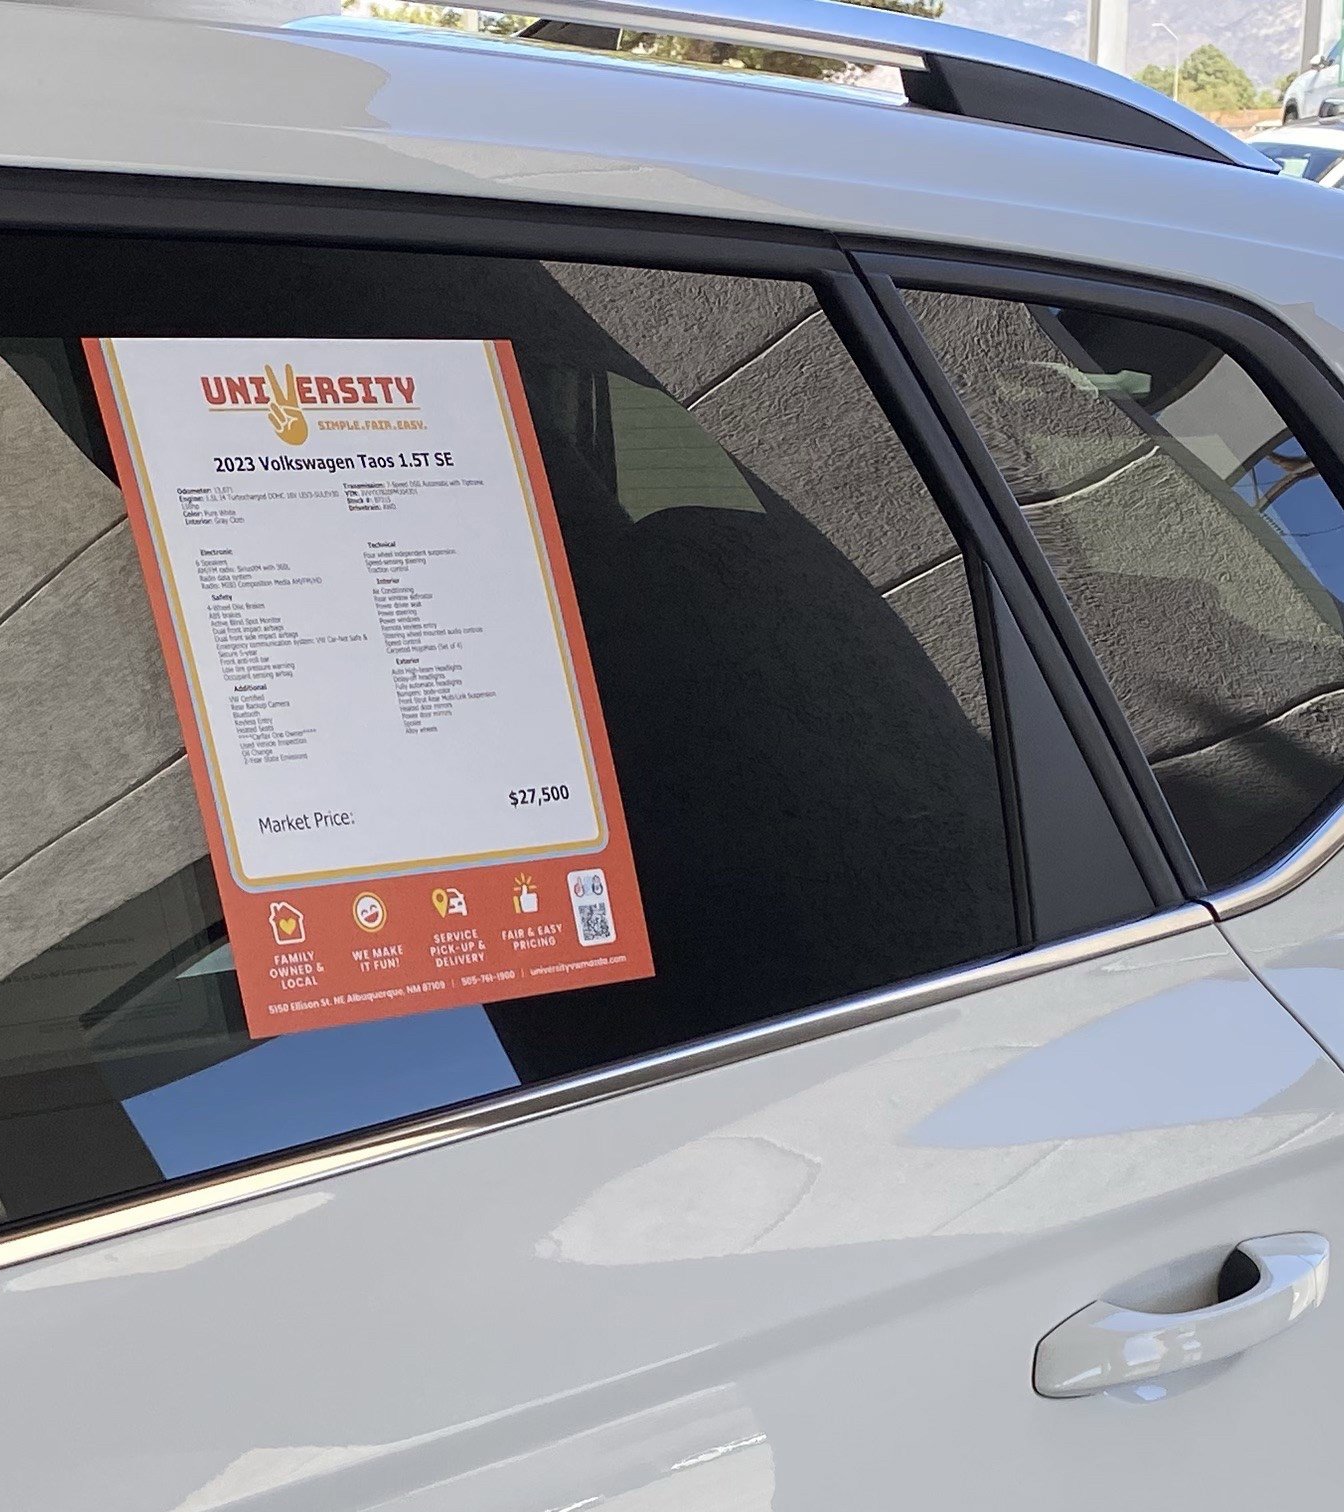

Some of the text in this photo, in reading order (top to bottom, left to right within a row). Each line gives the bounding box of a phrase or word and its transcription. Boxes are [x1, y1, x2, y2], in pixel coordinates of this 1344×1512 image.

[200, 365, 417, 406] UNIVERSITY
[213, 452, 454, 474] 2023 Volkswagen Taos 1.5T SE
[508, 784, 570, 808] $27,500
[257, 811, 356, 834] Market Price:
[433, 929, 479, 944] SERVICE
[501, 923, 563, 940] FAIR & EASY
[430, 940, 487, 957] PICK-UP &
[513, 936, 556, 951] PRICING
[274, 950, 315, 965] FAMILY
[352, 944, 404, 961] WE MAKE
[434, 952, 485, 969] DELIVERY
[269, 962, 325, 979] OWNED &
[360, 956, 400, 972] IT FUN!
[281, 976, 318, 990] LOCAL
